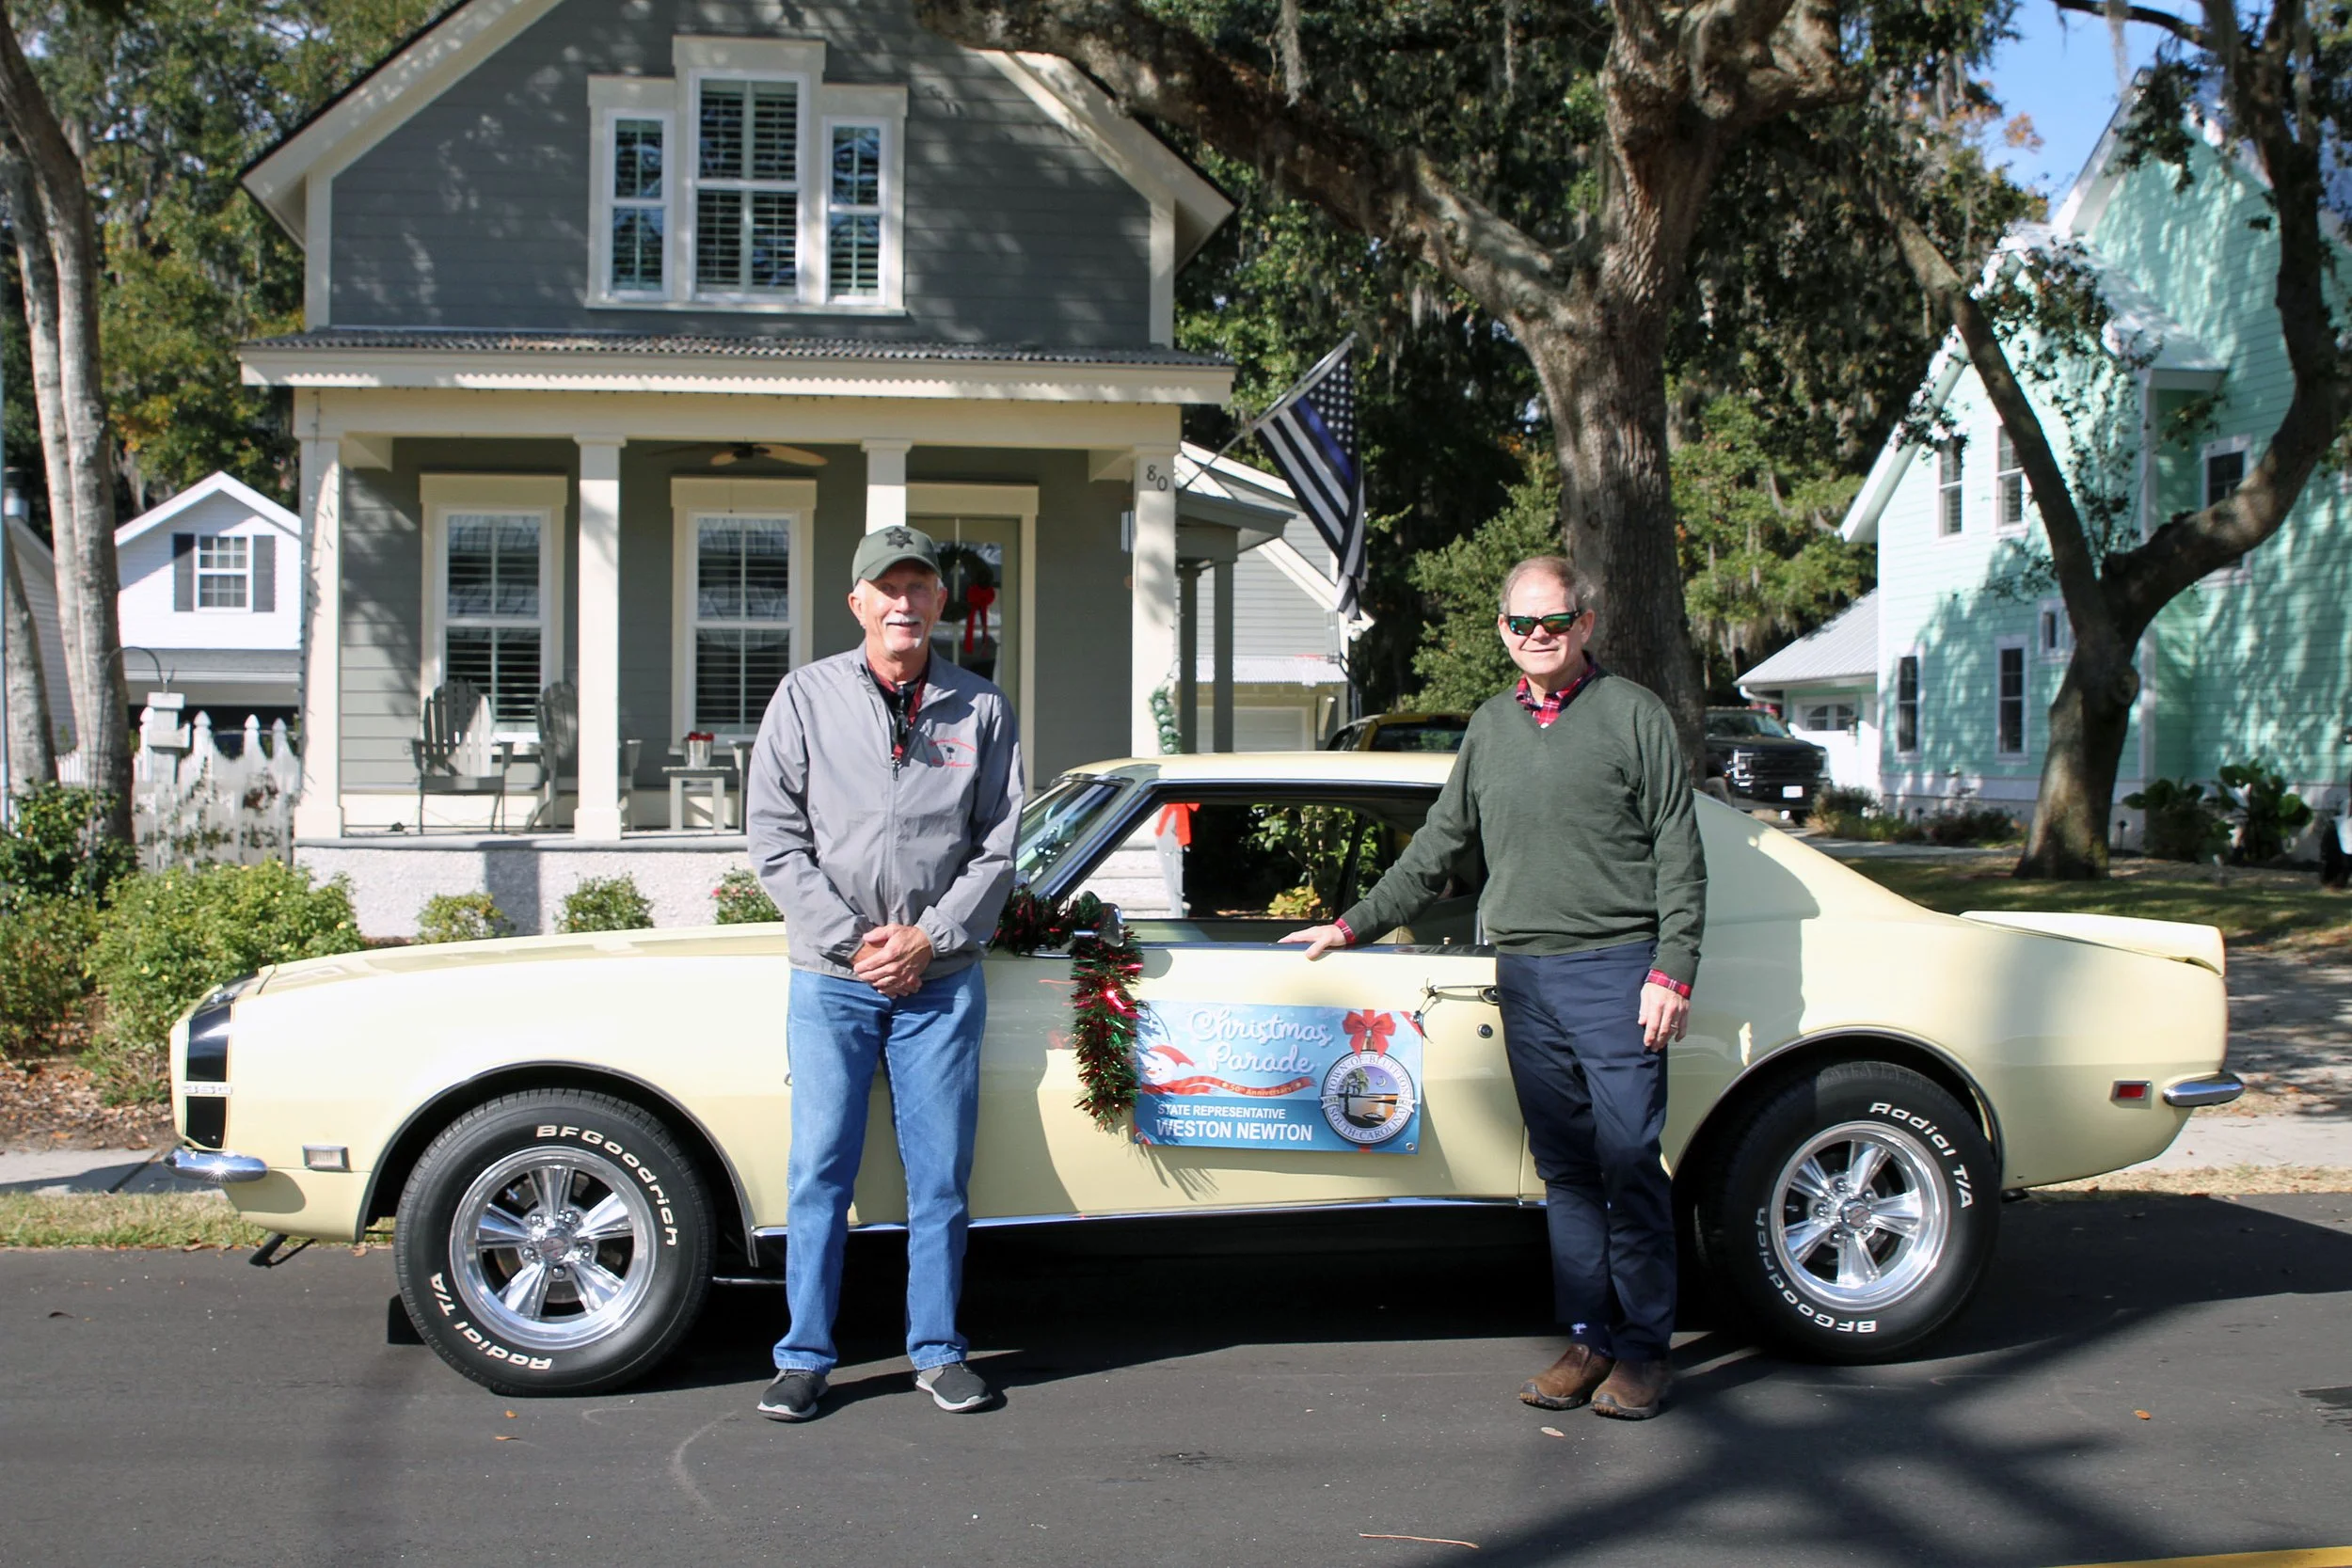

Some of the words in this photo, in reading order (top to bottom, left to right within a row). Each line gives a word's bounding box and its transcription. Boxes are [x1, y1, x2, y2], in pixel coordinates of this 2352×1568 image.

[1147, 465, 1168, 491] 80
[1188, 1007, 1333, 1047] Christmas
[1208, 1041, 1315, 1073] Parade
[1246, 1085, 1293, 1097] Anniversary
[1327, 1062, 1348, 1091] TOWN
[1157, 1103, 1190, 1116] STATE
[1193, 1104, 1286, 1119] REPRESENTATIVE
[1329, 1108, 1356, 1137] SOUTH
[1359, 1110, 1406, 1139] CAROLINA
[1156, 1119, 1232, 1138] WESTON
[1236, 1121, 1313, 1141] NEWTON
[1869, 1102, 1956, 1156] Radial
[1952, 1164, 1974, 1208] T/A
[536, 1125, 677, 1246] BFGoodrich
[1756, 1208, 1878, 1333] BFGoodrich
[430, 1272, 456, 1317] T/A
